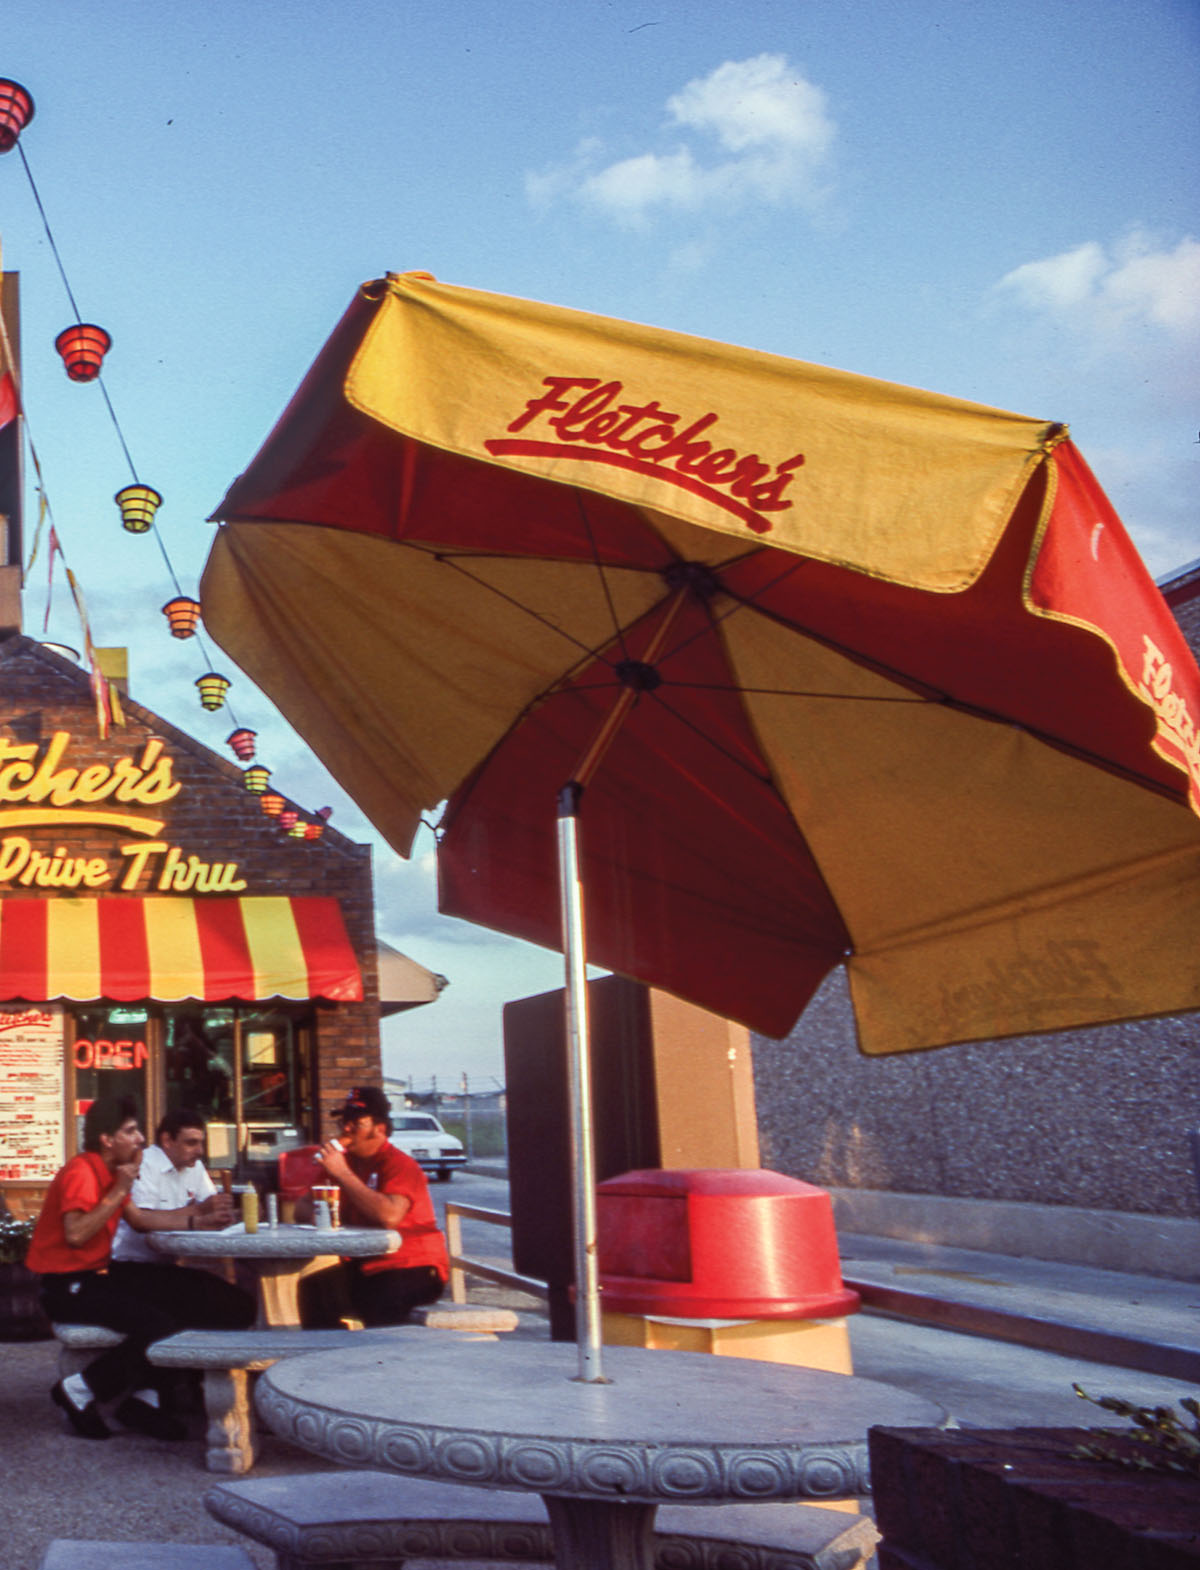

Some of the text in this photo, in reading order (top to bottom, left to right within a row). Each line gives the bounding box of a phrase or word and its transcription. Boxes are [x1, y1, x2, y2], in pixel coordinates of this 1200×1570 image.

[507, 376, 805, 513] Fletcher's
[121, 842, 248, 892] Thru
[72, 1040, 150, 1070] OPEN
